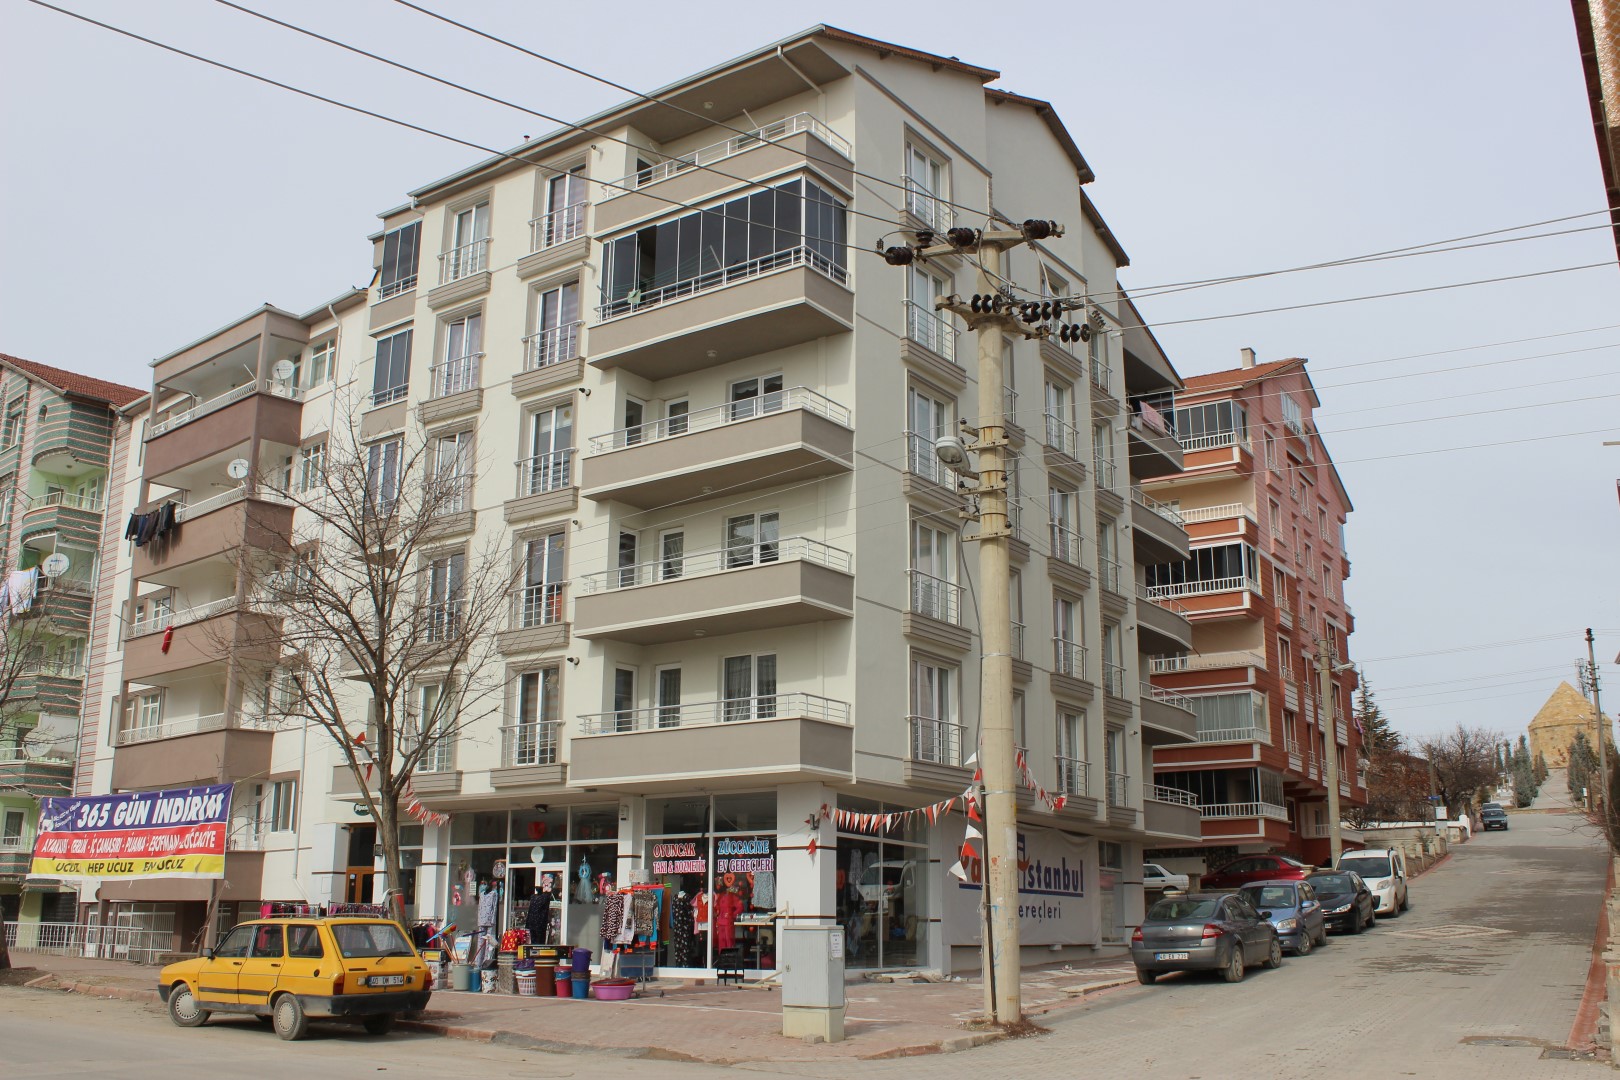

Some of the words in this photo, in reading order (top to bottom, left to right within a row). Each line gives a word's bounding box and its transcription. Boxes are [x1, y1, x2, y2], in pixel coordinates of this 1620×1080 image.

[77, 803, 112, 828] 365
[113, 794, 152, 827] GÜN
[152, 788, 225, 824] İNDİRİM
[653, 843, 696, 858] OYUNCAK
[717, 836, 770, 855] ZÜCCACİYE
[55, 862, 80, 873] UCUZ
[87, 862, 105, 873] HEP
[106, 861, 134, 873] UCUZ
[156, 858, 186, 871] UCUZ
[653, 860, 667, 874] TAKI
[668, 861, 674, 874] &
[674, 856, 707, 874] KOZMETİK
[717, 859, 729, 874] EV
[729, 854, 774, 876] GEREÇLERİ
[1018, 899, 1061, 924] ereçleri
